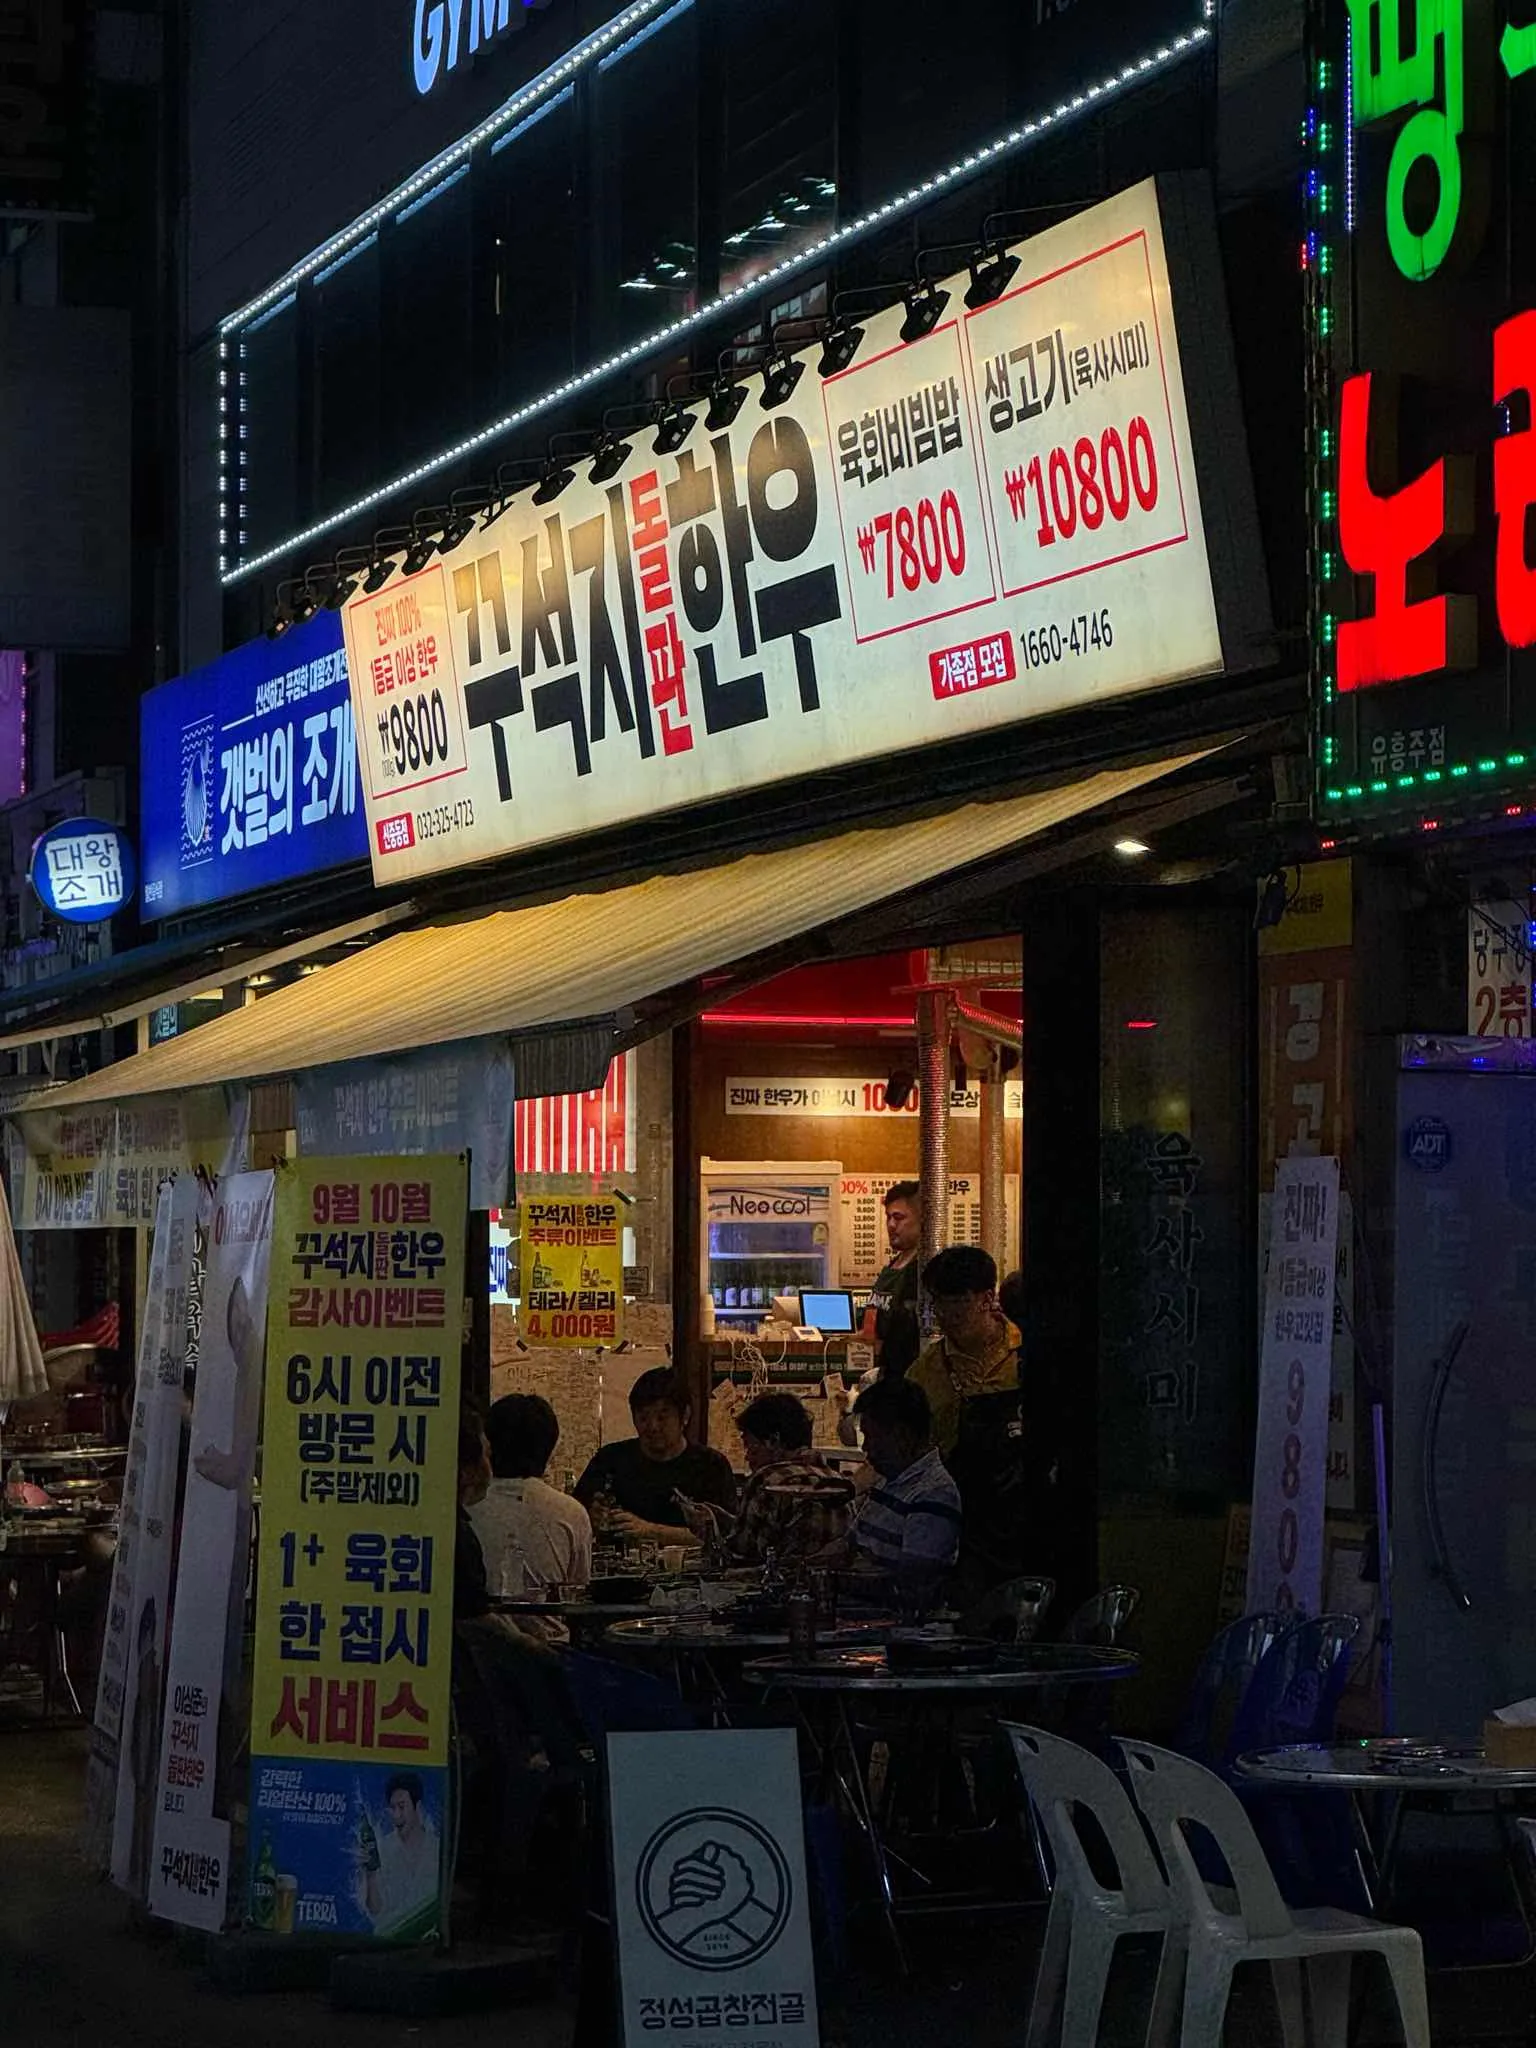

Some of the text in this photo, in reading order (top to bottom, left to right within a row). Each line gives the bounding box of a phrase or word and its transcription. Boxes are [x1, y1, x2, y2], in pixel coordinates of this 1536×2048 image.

[838, 375, 964, 488] 육회비빔밥
[1004, 415, 1159, 548] ₩10800
[857, 488, 967, 599] ₩7800
[375, 592, 422, 647] 진짜 100%
[453, 416, 842, 802] 꾸석지 돌판 한우
[370, 635, 438, 697] 1등급 이상 한우
[938, 638, 1008, 693] 가족점 모집
[1018, 608, 1114, 670] 1660-4746
[255, 676, 285, 718] 신선하고
[285, 663, 309, 704] 푸짐한
[377, 687, 448, 776] ₩9800
[1370, 725, 1445, 776] 유흥주점
[220, 698, 357, 857] 갯벌의 조개
[49, 839, 115, 872] 대왕
[58, 869, 122, 905] 조개
[1476, 981, 1527, 1038] 2층
[728, 1087, 761, 1107] 진짜
[763, 1087, 809, 1107] 한우가
[1410, 1133, 1446, 1154] ADT
[312, 1183, 361, 1225] 9월
[369, 1182, 432, 1225] 10월
[528, 1204, 577, 1227] 꾸석지
[584, 1204, 617, 1227] 한우
[292, 1231, 376, 1281] 꾸석지
[390, 1229, 447, 1280] 한우
[527, 1227, 617, 1248] 주류이벤트
[287, 1287, 446, 1329] 감사이벤트
[527, 1313, 616, 1339] 4,000원
[528, 1291, 616, 1312] 테라/켈리
[286, 1353, 441, 1407] 6시 이전
[298, 1412, 427, 1466] 방문 시
[300, 1467, 421, 1507] (주말제외)
[279, 1531, 434, 1595] 1+ 육회
[279, 1600, 430, 1668] 한 접시
[270, 1676, 431, 1751] 서비스
[313, 1791, 347, 1813] 100%
[297, 1899, 339, 1925] TERRA
[639, 1992, 805, 2031] 정성곱창전골
